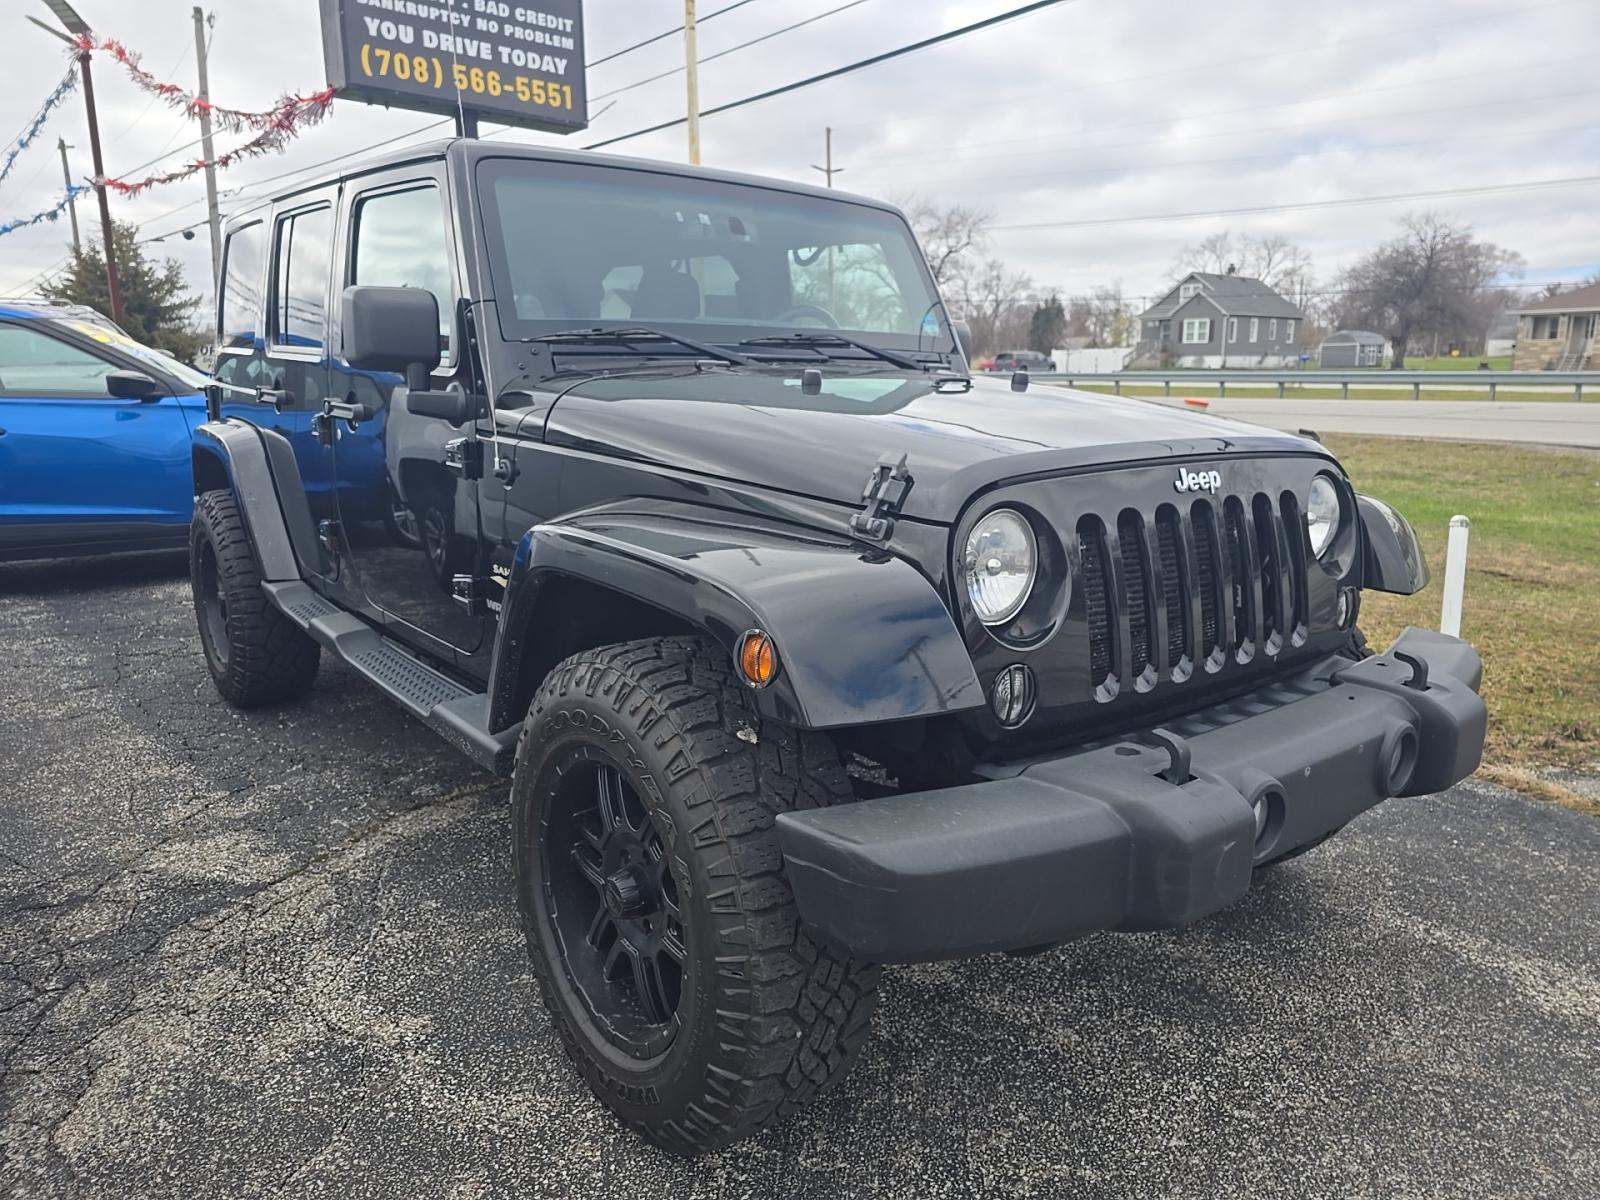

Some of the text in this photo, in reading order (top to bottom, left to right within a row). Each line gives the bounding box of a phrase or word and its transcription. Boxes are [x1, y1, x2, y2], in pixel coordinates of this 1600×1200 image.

[356, 0, 574, 50] ANKRUPTCY NO PROBLEM
[474, 0, 574, 32] BAD CREDIT
[363, 16, 568, 75] YOU DRIVE TODAY
[360, 44, 572, 110] (708) 566-5551
[1174, 467, 1221, 494] Jeep
